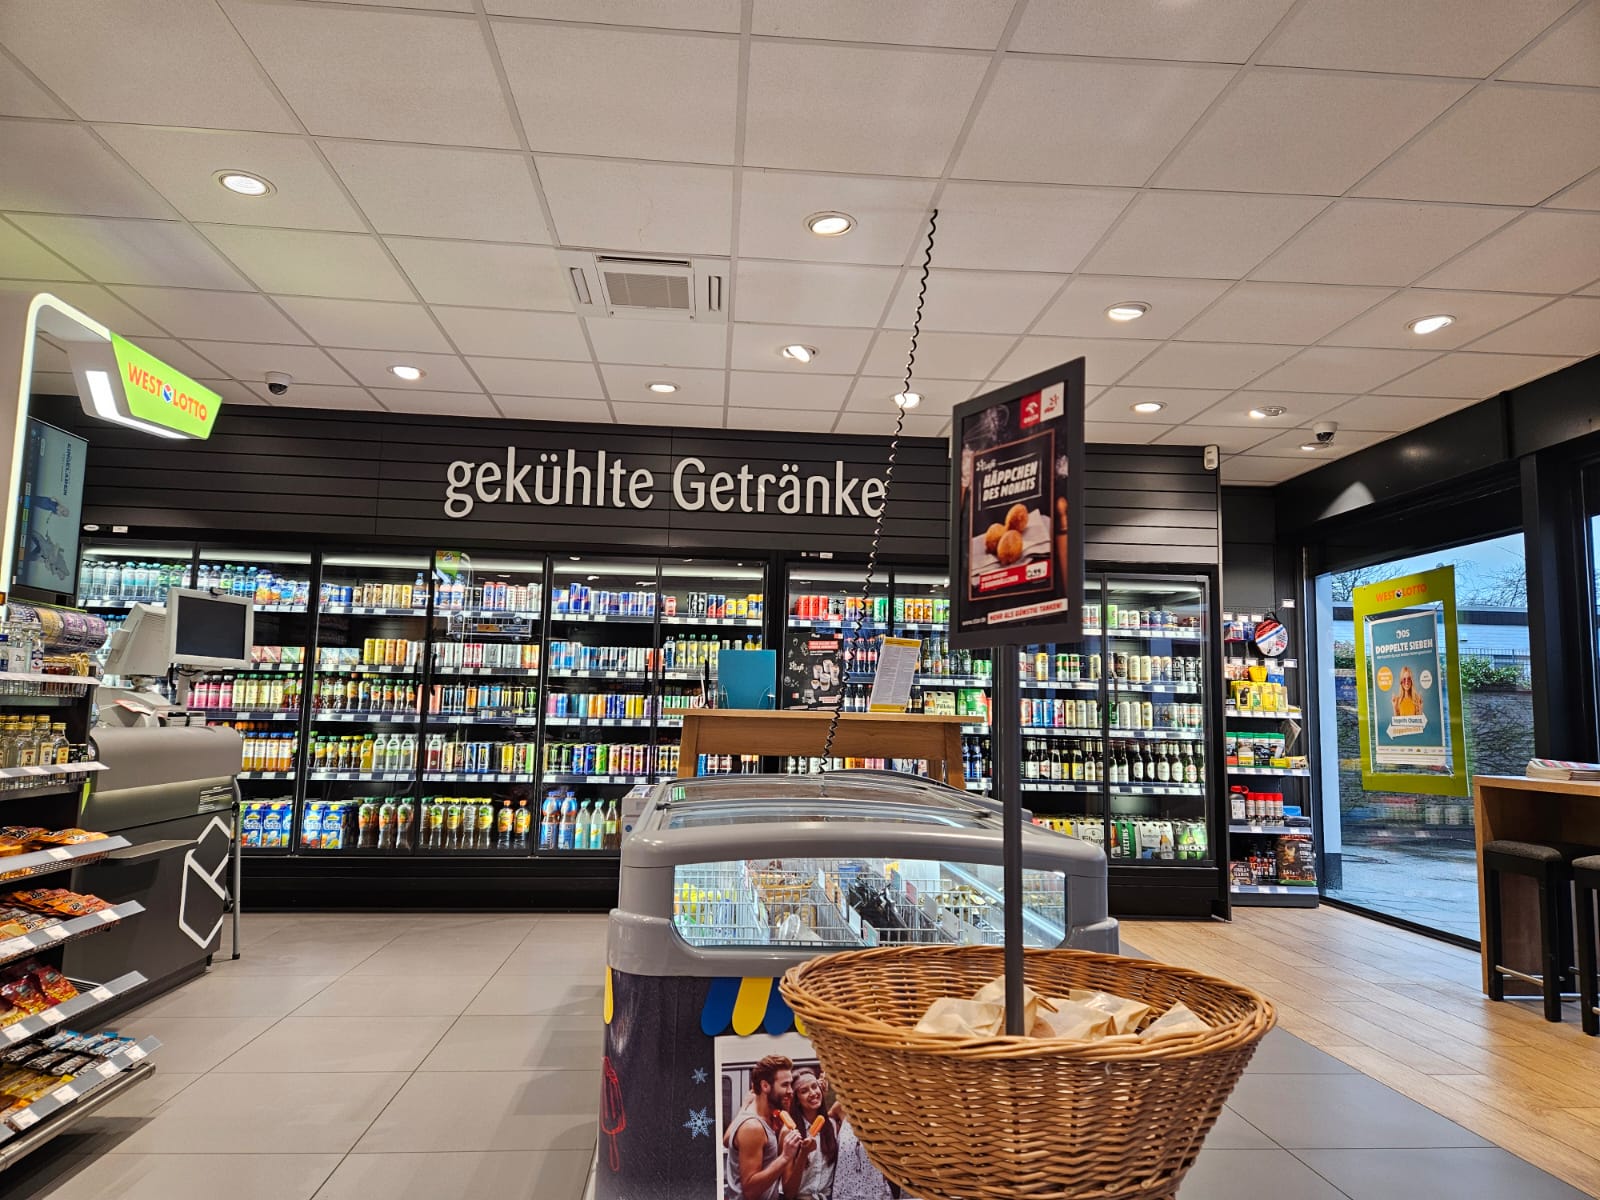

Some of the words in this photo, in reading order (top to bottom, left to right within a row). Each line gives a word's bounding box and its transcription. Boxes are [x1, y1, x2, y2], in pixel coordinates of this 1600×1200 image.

[128, 362, 163, 397] WEST
[172, 389, 208, 421] LOTTO
[444, 446, 654, 519] gekühlte
[673, 457, 887, 518] Getränke
[983, 461, 1038, 489] HÄPPCHEN
[982, 486, 1001, 502] DES
[1000, 477, 1036, 498] MONATS
[1376, 591, 1395, 602] WEST
[1402, 584, 1427, 597] LOTTO
[1375, 641, 1409, 655] DOPPELTE
[1409, 638, 1433, 650] SIEBEN
